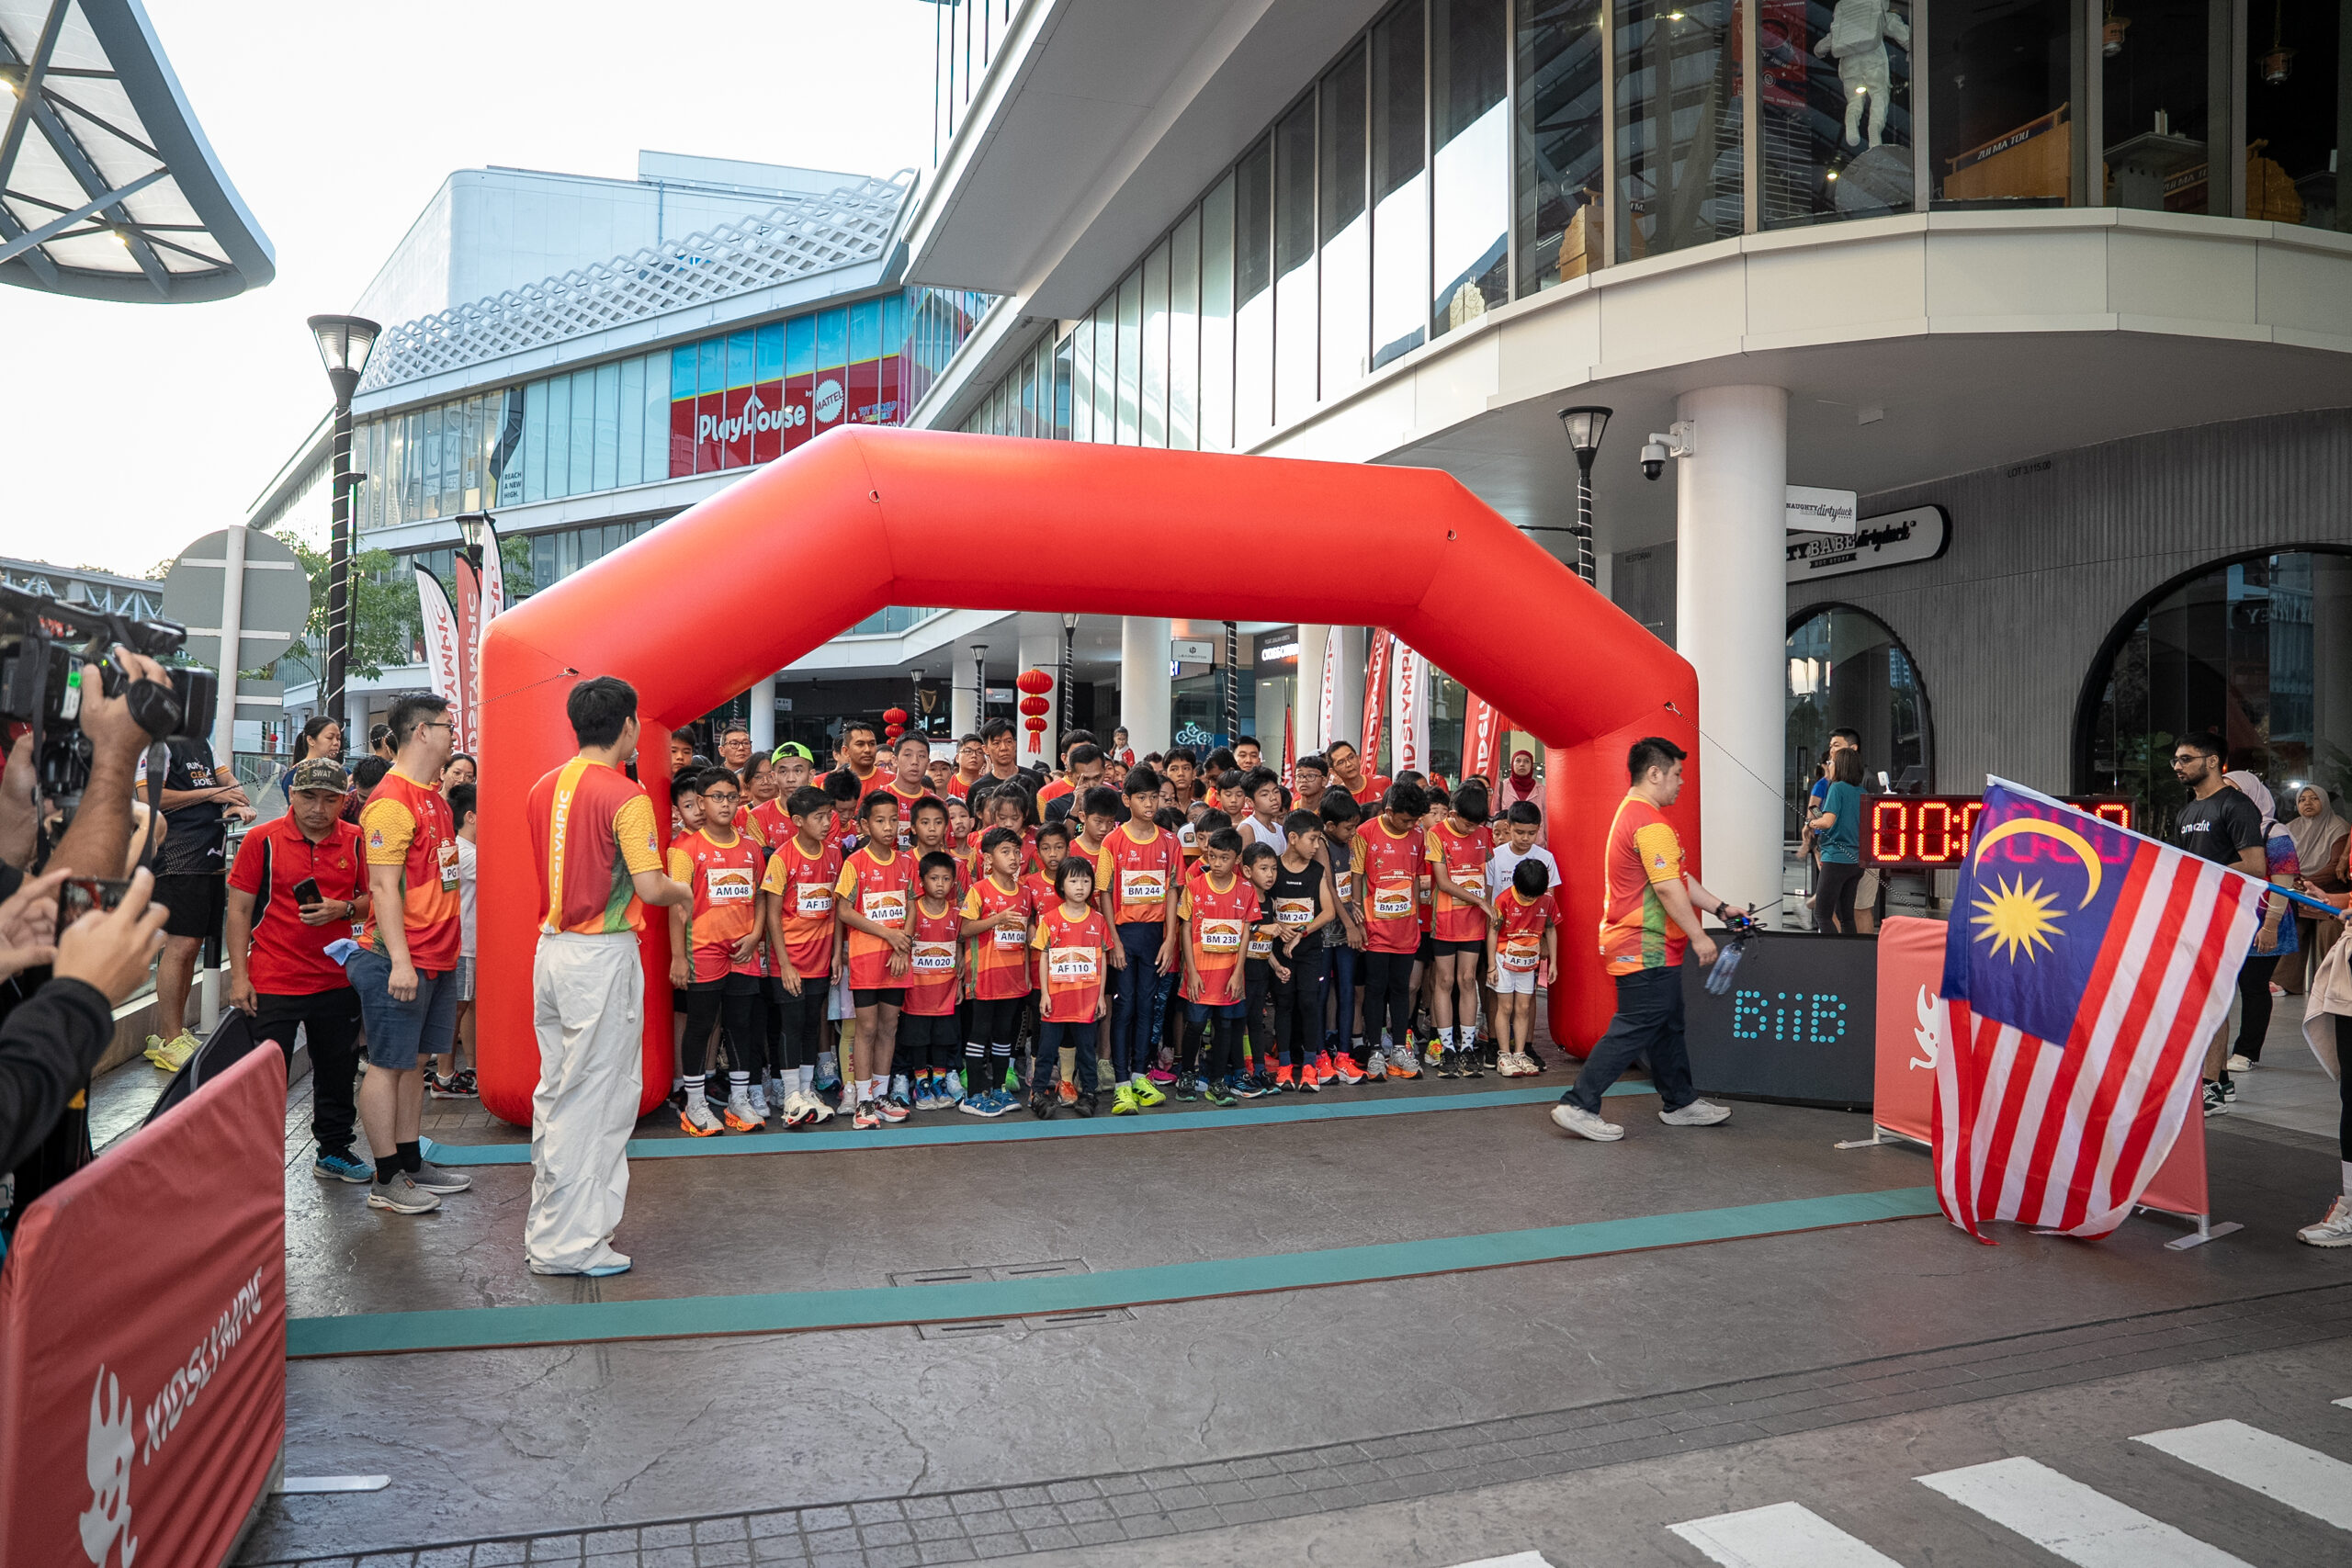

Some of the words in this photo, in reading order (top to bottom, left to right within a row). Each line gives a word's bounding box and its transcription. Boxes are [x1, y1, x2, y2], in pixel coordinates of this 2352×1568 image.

[1993, 141, 2008, 153] MA
[2010, 130, 2030, 145] TOU
[816, 390, 843, 412] MATTEL
[851, 412, 857, 421] A
[504, 472, 522, 480] REACH
[1809, 535, 1856, 558] BABE
[1402, 648, 1416, 772] IDSLYMPI
[312, 768, 332, 778] SWAT
[716, 886, 732, 896] AM
[735, 886, 749, 895] 048
[1129, 887, 1143, 896] BM
[806, 900, 818, 909] AF
[1396, 903, 1408, 911] 250
[872, 909, 887, 919] AM
[889, 908, 902, 917] 044
[1294, 913, 1308, 921] 247
[1001, 932, 1014, 941] AM
[1252, 942, 1264, 951] BM
[918, 958, 933, 966] AM
[1524, 957, 1535, 965] 136
[143, 1266, 262, 1466] KIDSLYMPIC
